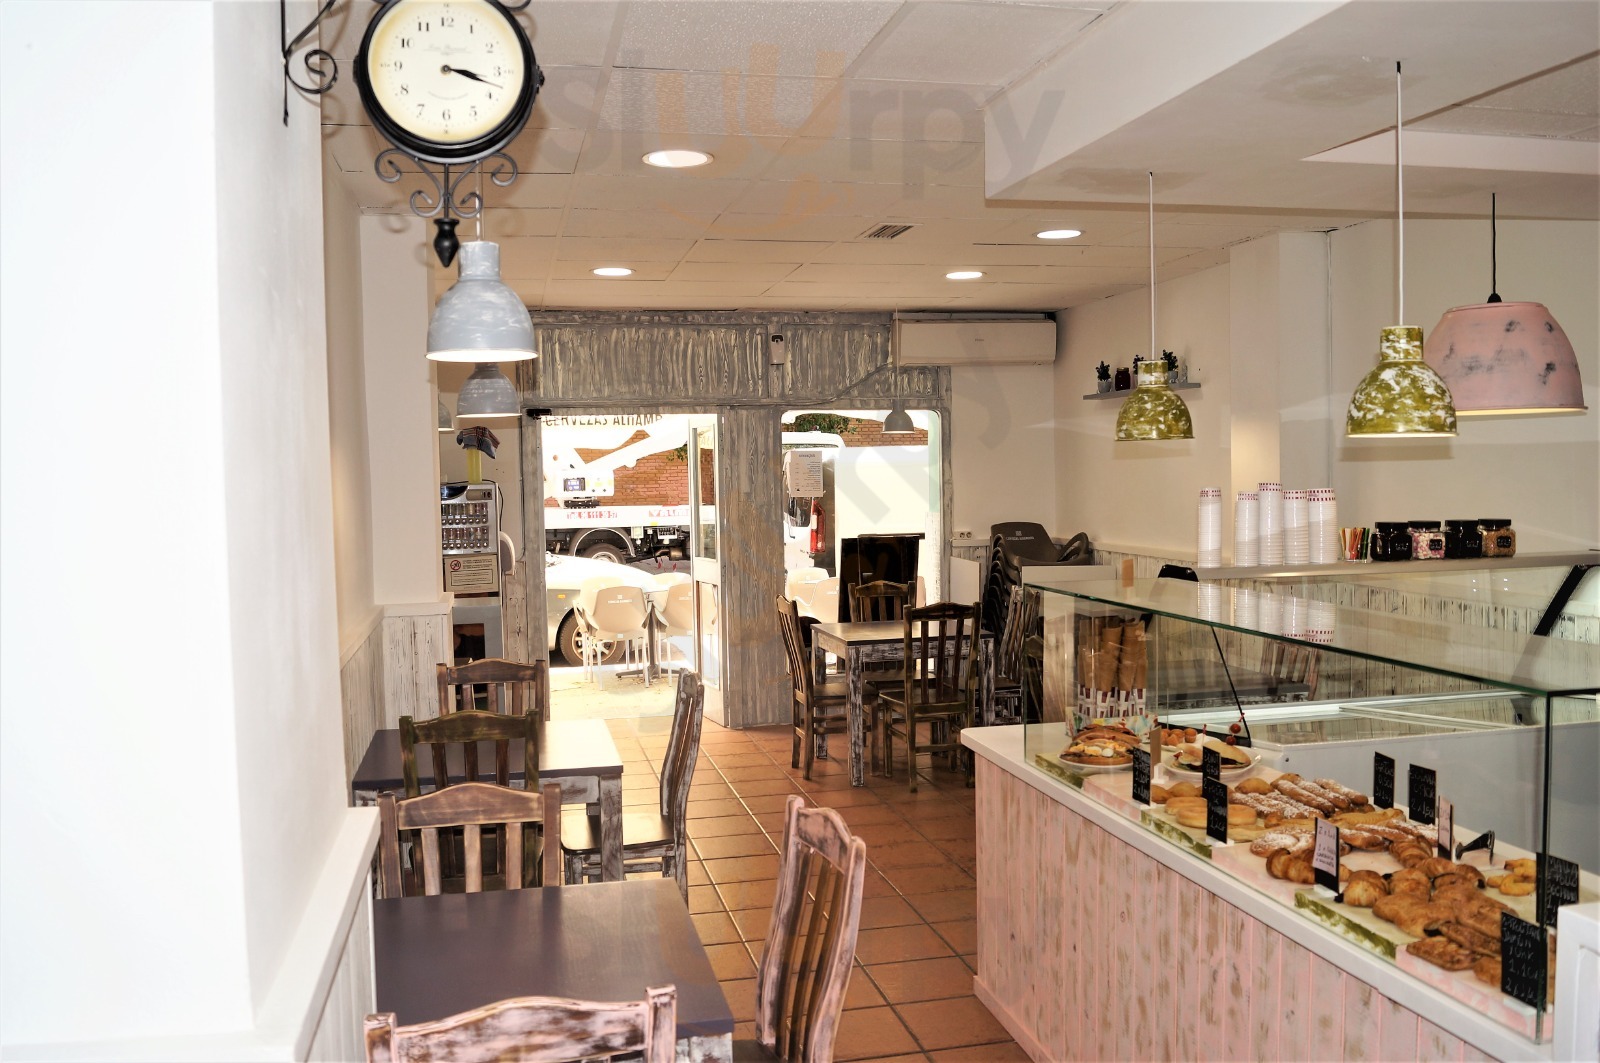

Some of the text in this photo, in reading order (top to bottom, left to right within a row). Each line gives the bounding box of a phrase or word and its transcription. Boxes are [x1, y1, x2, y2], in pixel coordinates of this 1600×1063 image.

[418, 21, 430, 32] 11
[441, 16, 455, 28] 12
[469, 24, 474, 34] 1
[401, 38, 414, 49] 10
[485, 42, 494, 54] 2
[394, 61, 403, 72] 9
[493, 66, 502, 78] 3
[400, 84, 409, 96] 8
[485, 91, 493, 101] 4
[417, 103, 425, 118] 7
[442, 109, 451, 121] 6
[469, 105, 478, 118] 5
